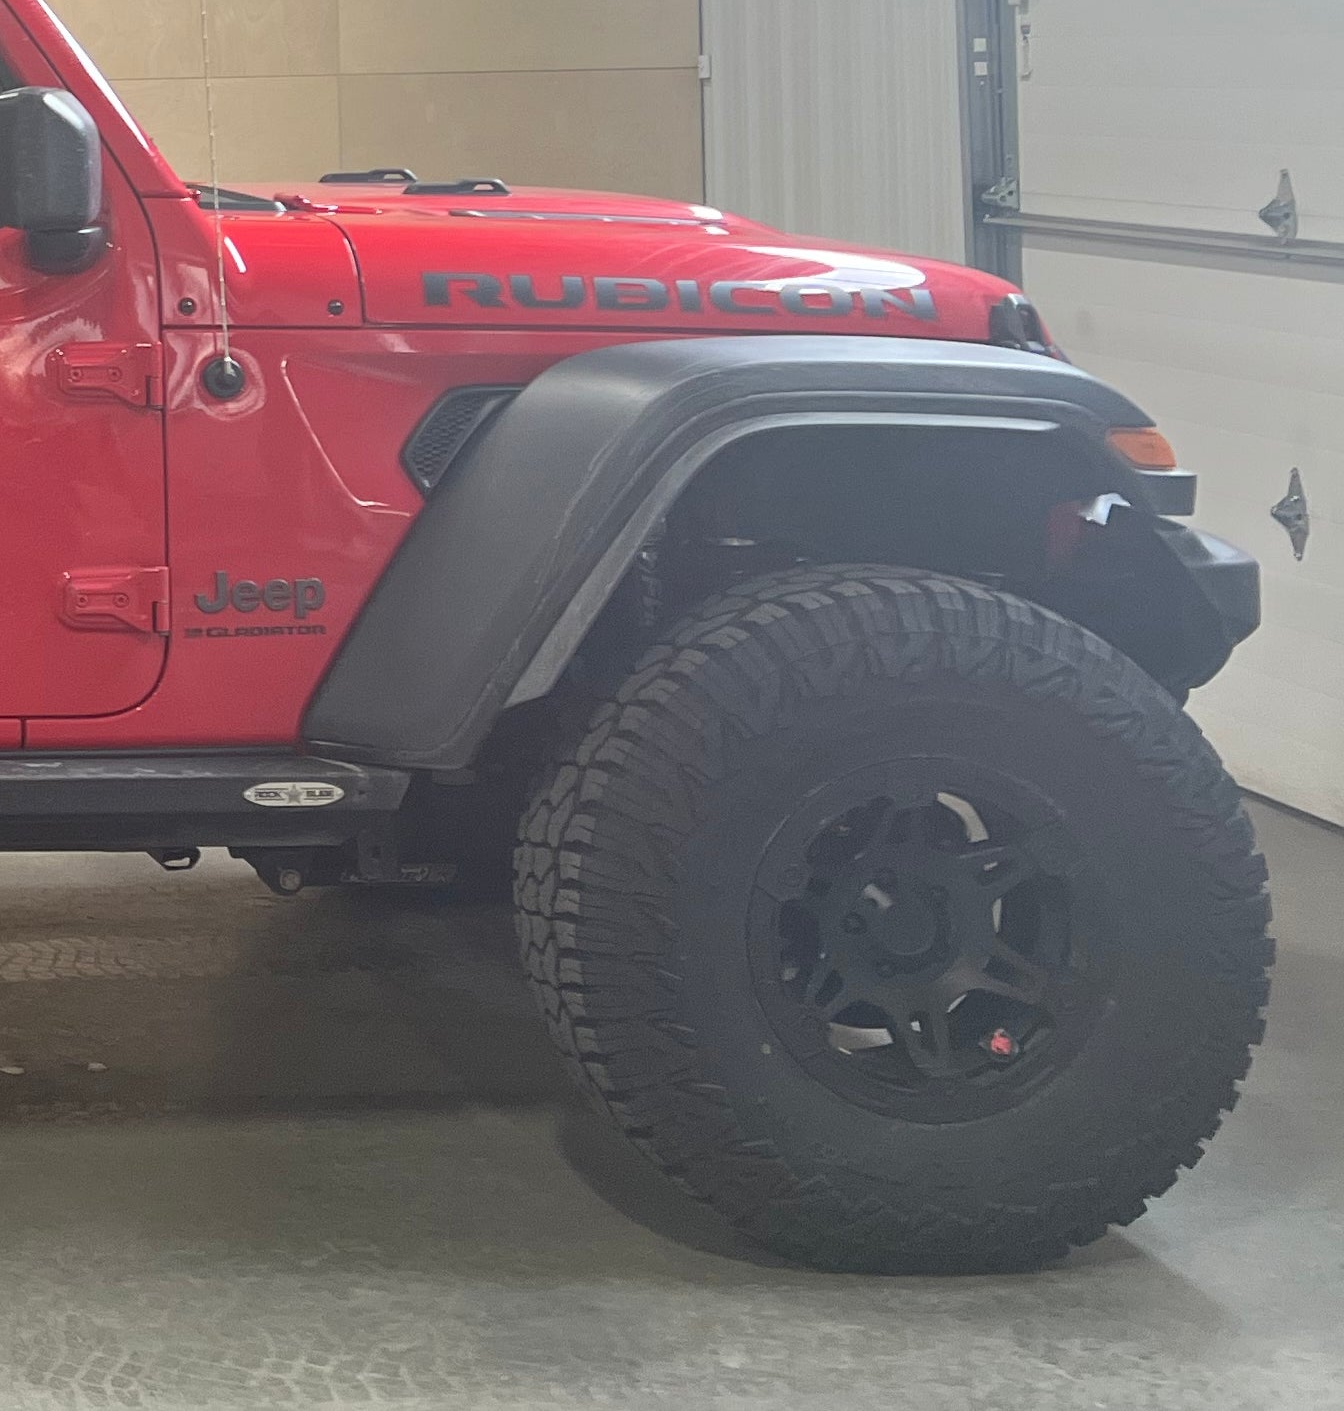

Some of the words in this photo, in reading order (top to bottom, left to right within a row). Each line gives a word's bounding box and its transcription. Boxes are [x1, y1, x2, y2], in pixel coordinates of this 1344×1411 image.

[420, 271, 939, 322] RUBICON
[195, 569, 326, 619] Jeep
[205, 624, 327, 638] GLADIATOR
